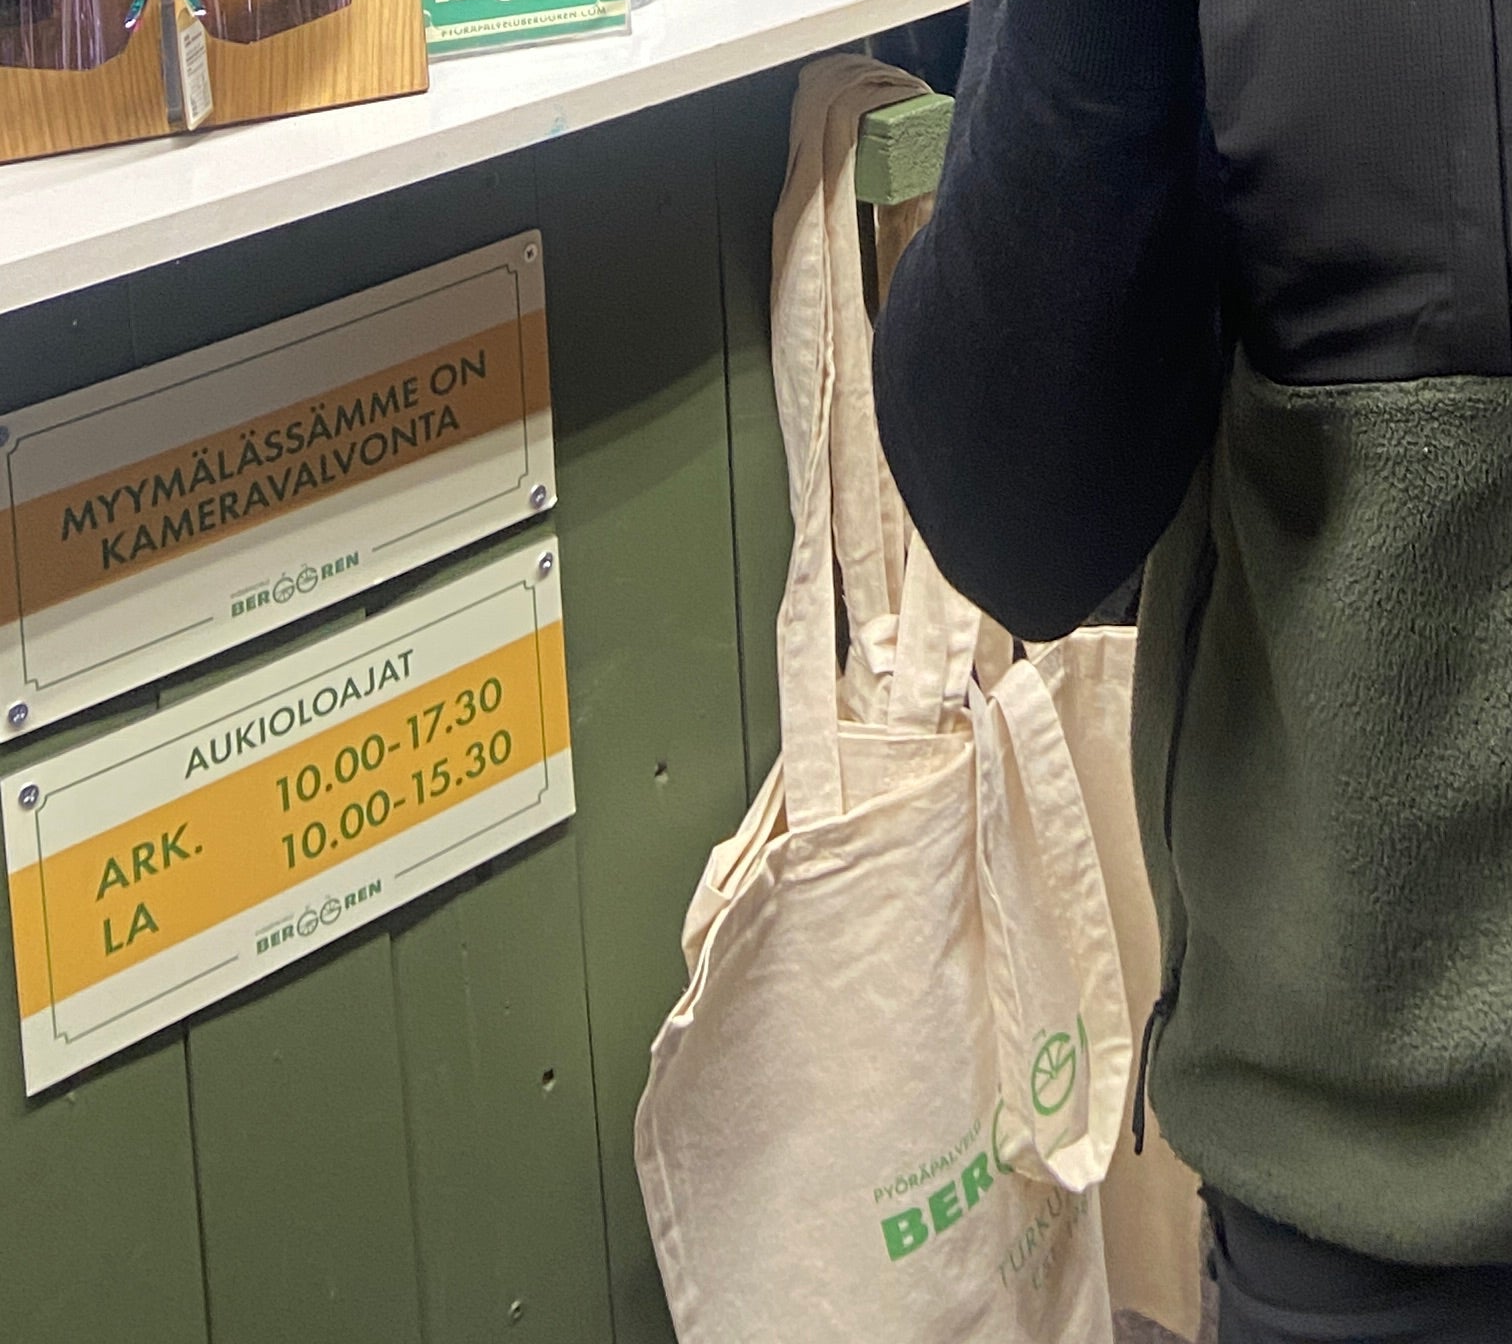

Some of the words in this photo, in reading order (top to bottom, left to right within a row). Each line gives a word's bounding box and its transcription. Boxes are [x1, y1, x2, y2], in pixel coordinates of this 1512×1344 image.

[60, 377, 419, 542] MYYMÄLÄSSÄMME
[429, 348, 486, 396] ON
[100, 404, 460, 571] KAMERAVALVONTA
[95, 823, 204, 902] ARK.
[274, 676, 503, 813] 10.00-17.30
[183, 649, 415, 780] AUKIOLOAJAT
[103, 901, 160, 957] LA
[280, 729, 513, 870] 10.00-15.30
